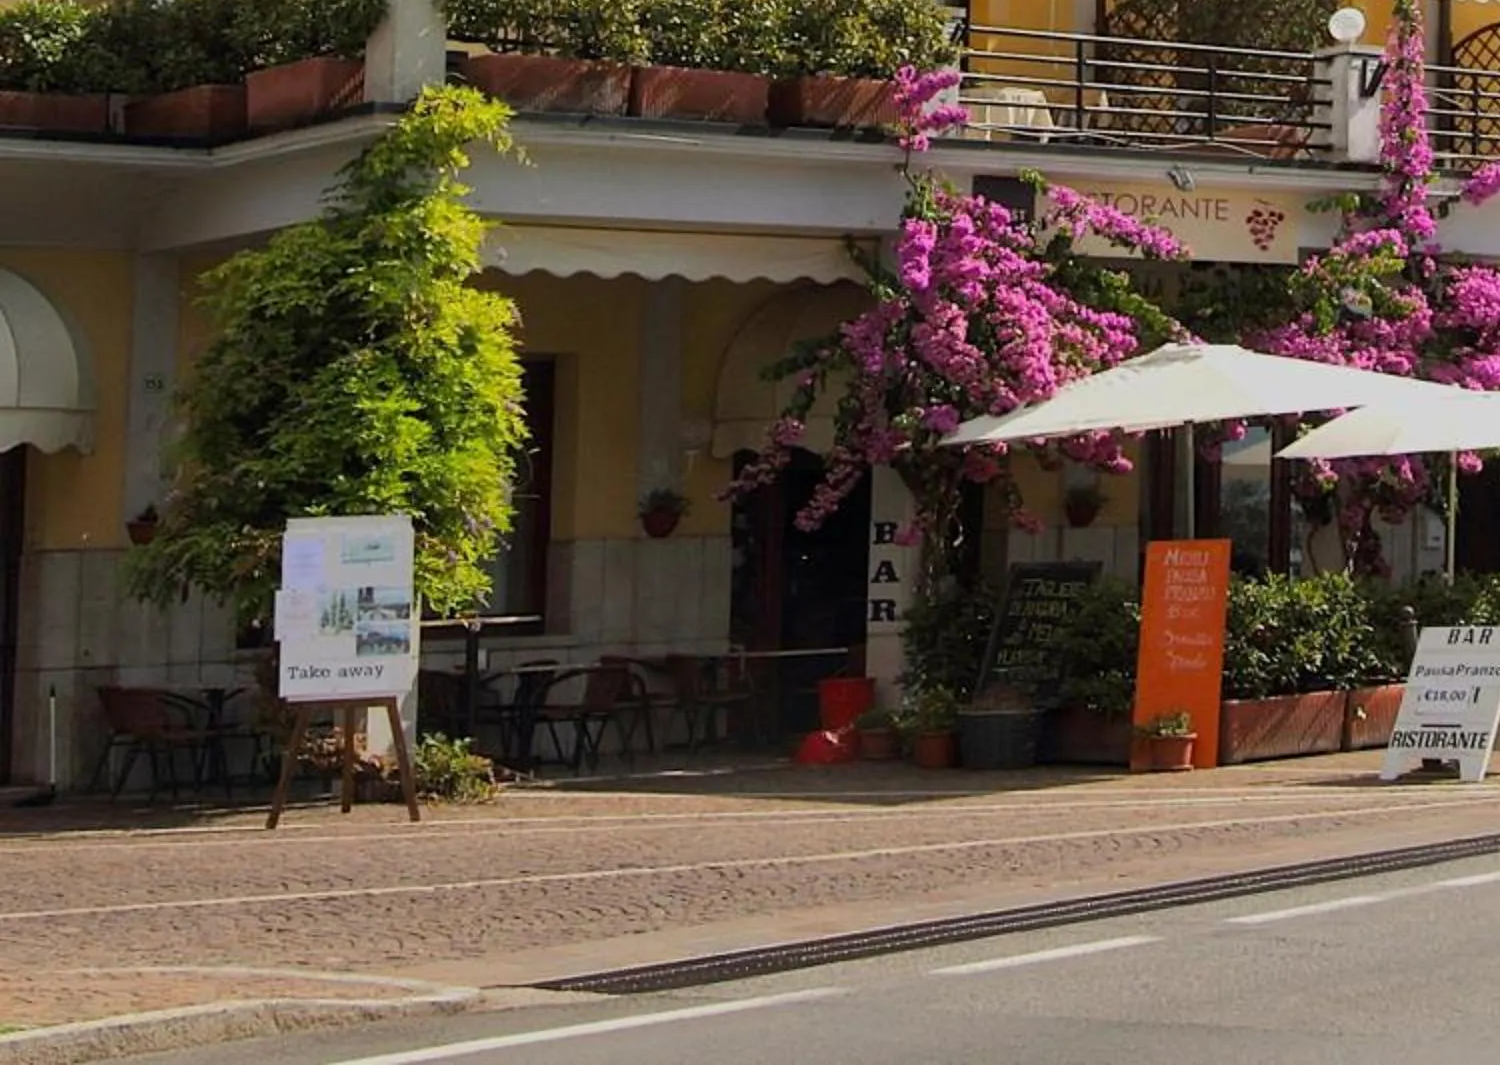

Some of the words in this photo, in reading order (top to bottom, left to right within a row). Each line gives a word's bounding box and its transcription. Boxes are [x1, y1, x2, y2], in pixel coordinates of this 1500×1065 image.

[1088, 191, 1229, 221] TORANTE
[1447, 628, 1493, 645] BAR
[287, 666, 331, 680] Take
[337, 664, 385, 679] away
[1391, 730, 1489, 750] RISTORANTE
